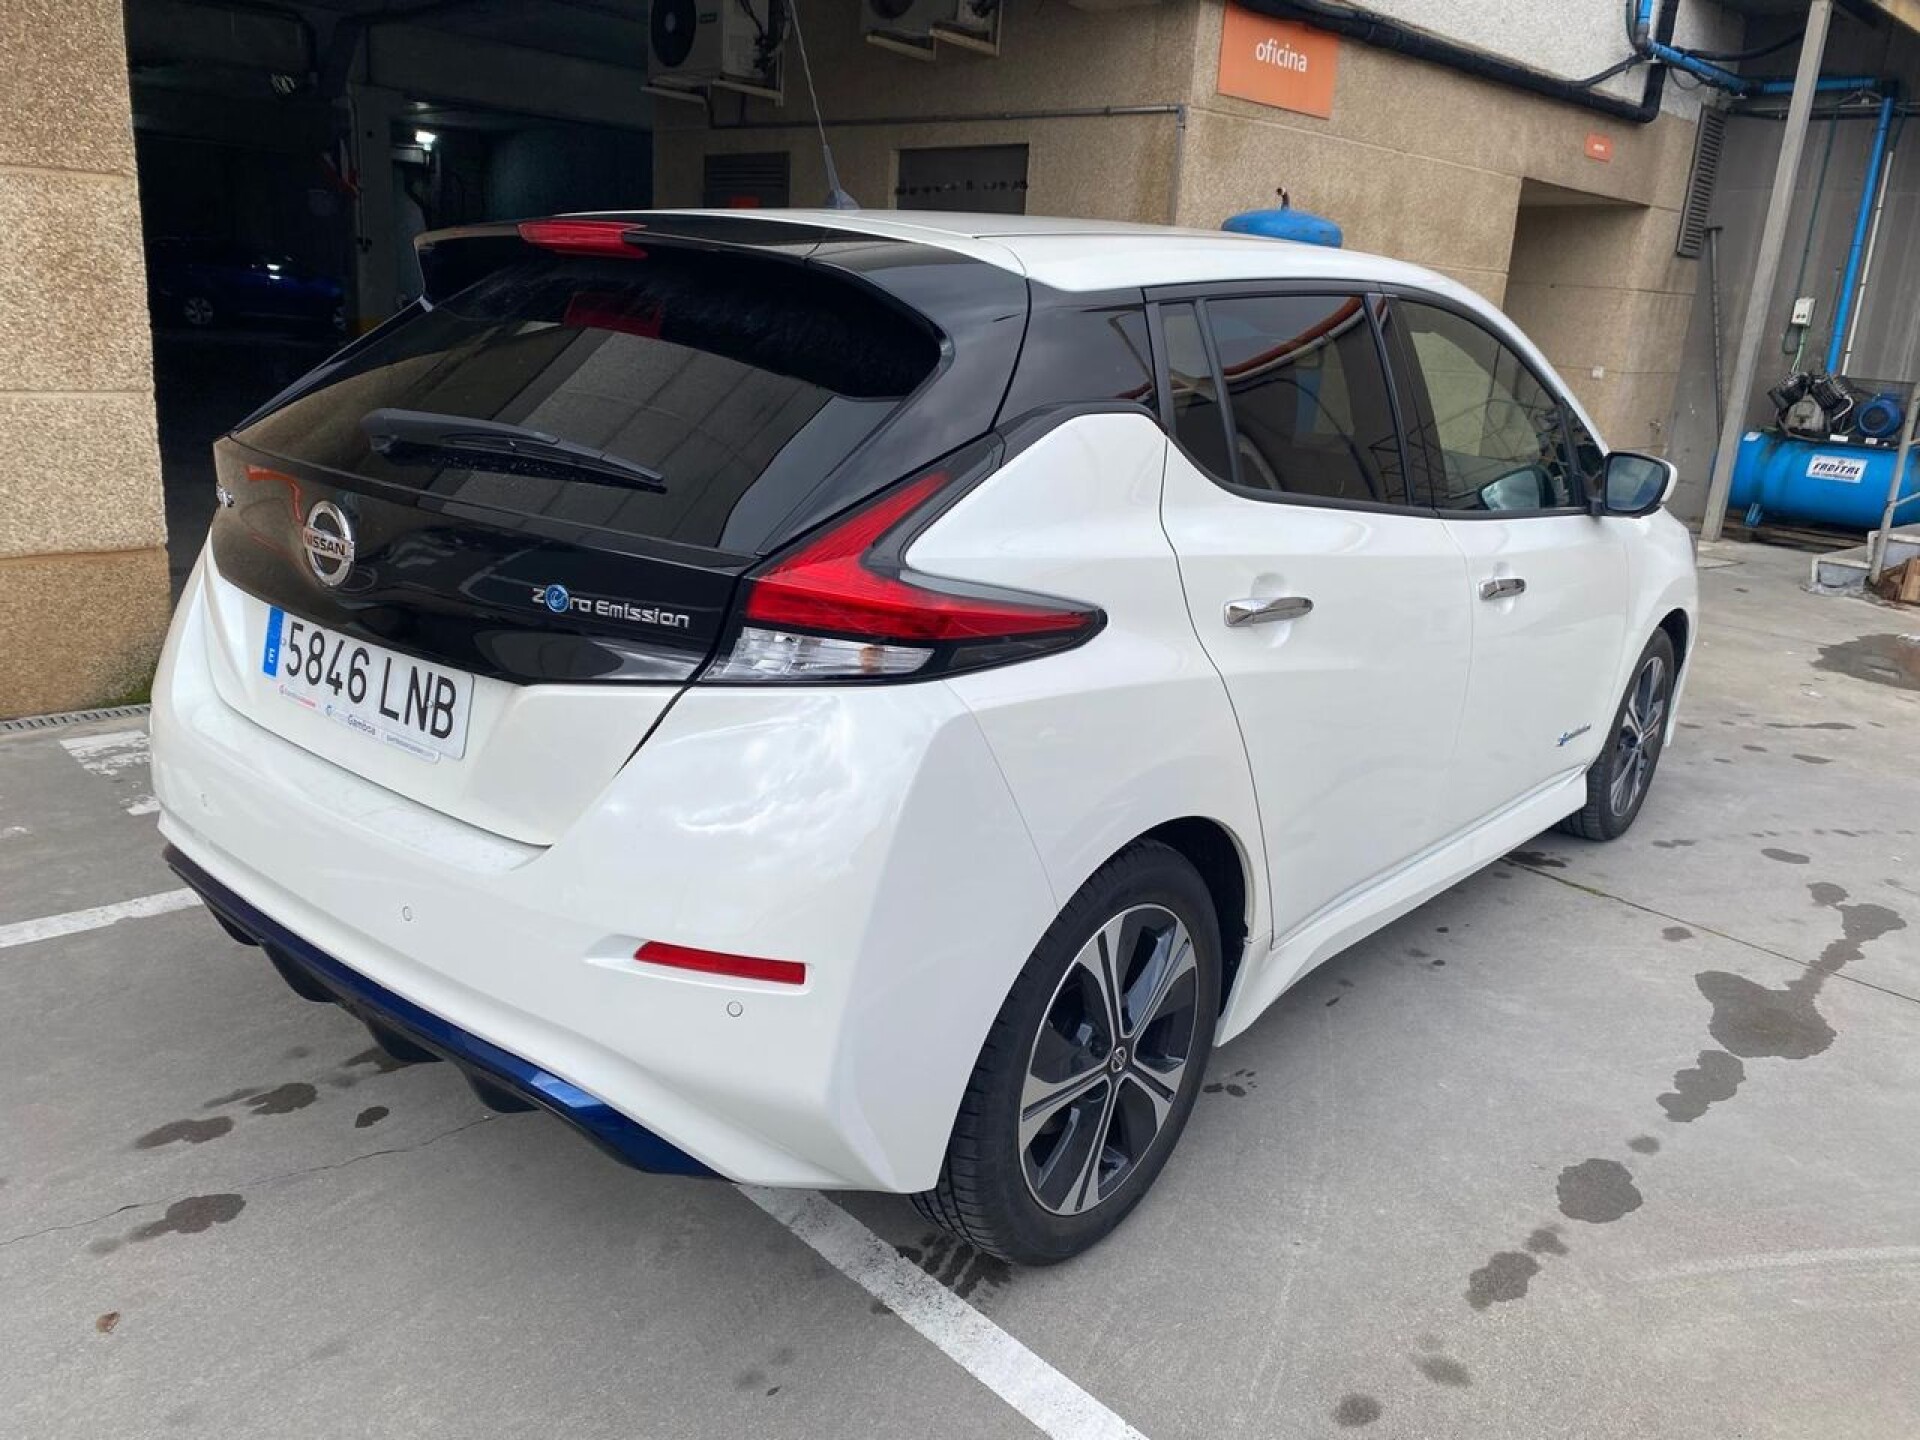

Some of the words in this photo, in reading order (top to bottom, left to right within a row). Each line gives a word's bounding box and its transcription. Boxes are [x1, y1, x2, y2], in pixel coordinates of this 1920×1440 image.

[1256, 38, 1308, 73] oficina
[304, 531, 346, 557] NISSAN
[595, 600, 691, 629] Emission
[268, 647, 276, 664] E
[286, 621, 370, 704] 5846
[378, 656, 457, 739] LNB
